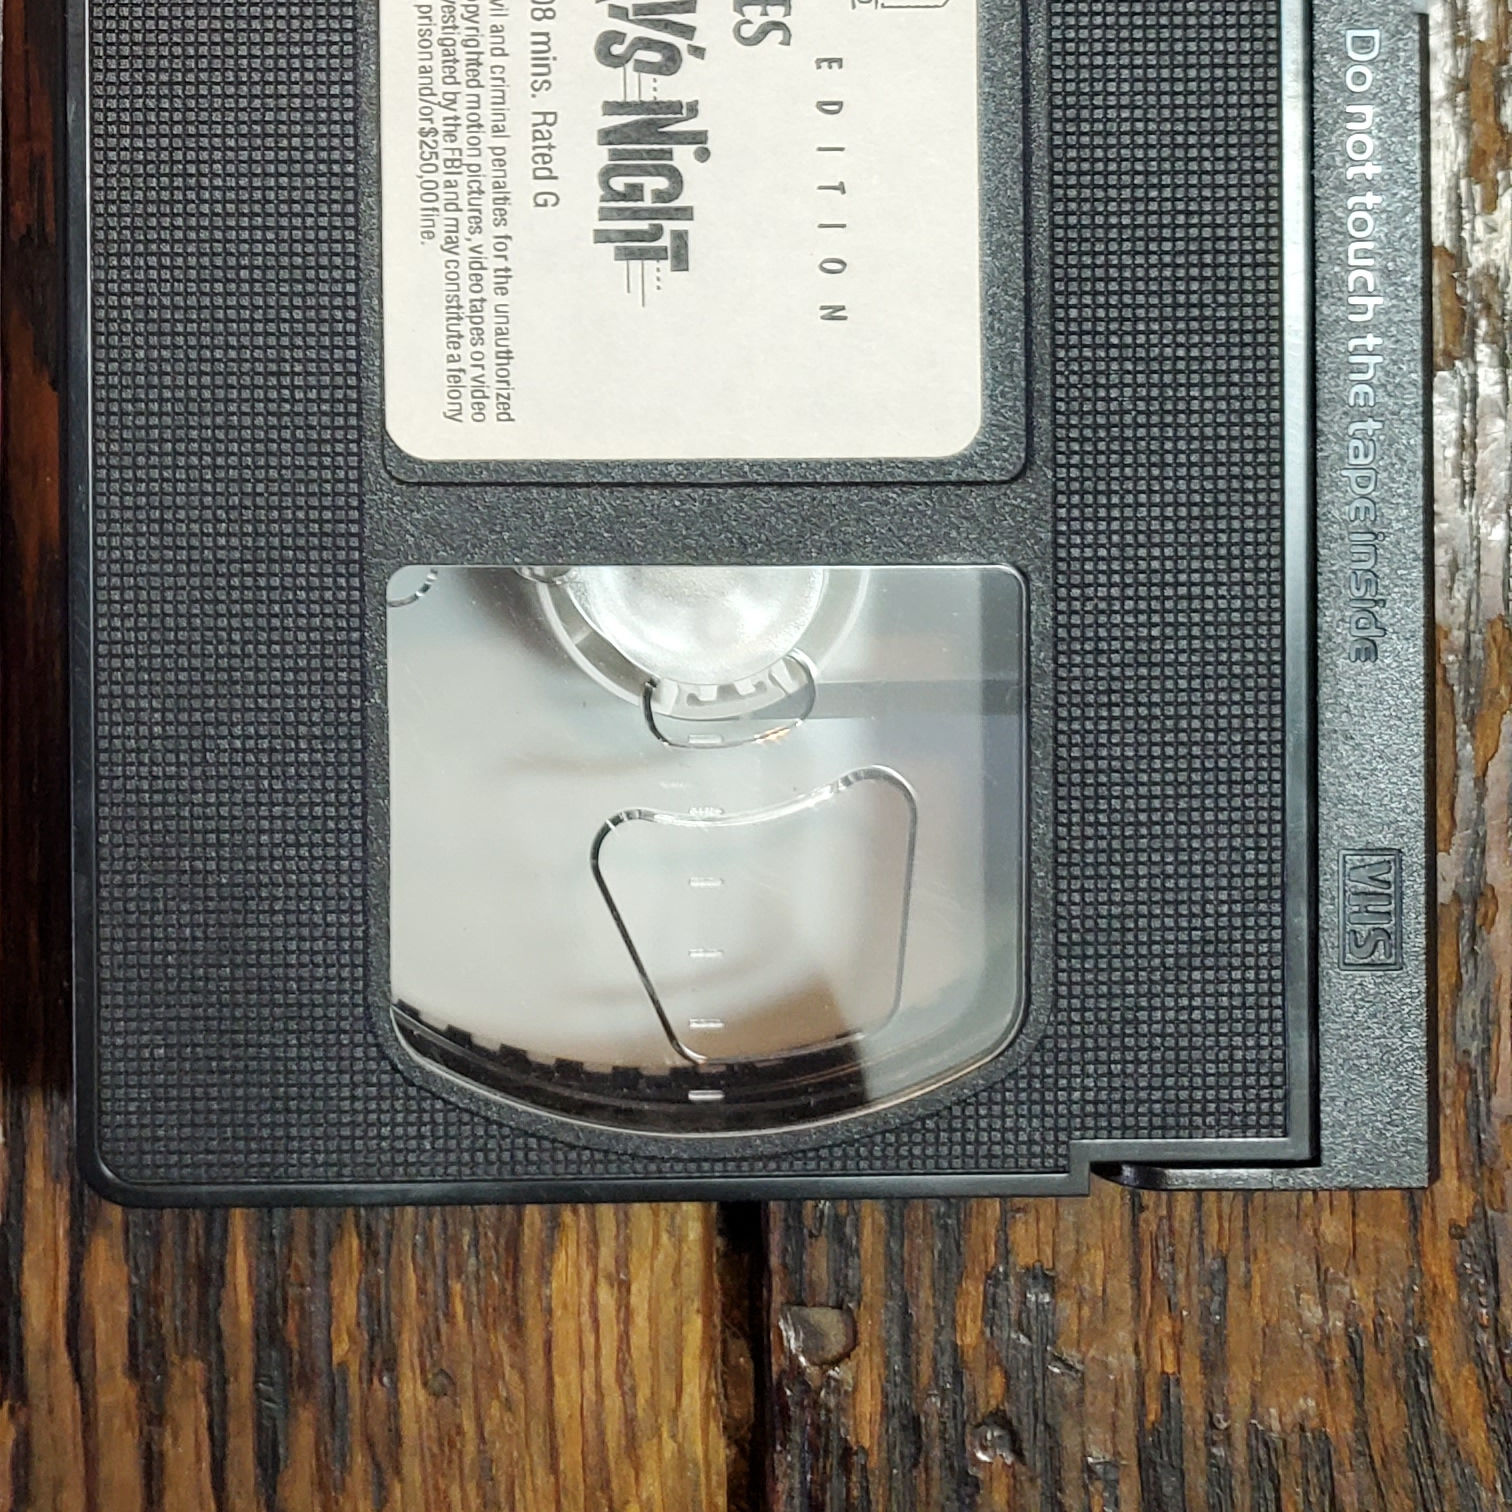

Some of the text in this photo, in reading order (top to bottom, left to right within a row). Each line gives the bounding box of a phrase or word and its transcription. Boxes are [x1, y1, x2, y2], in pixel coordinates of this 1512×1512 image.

[413, 4, 436, 60] prison
[489, 25, 509, 56] and
[530, 32, 558, 98] mins.
[417, 65, 439, 124] and/or
[438, 92, 461, 111] by
[490, 65, 510, 138] criminal
[443, 115, 463, 143] the
[465, 94, 485, 157] motion
[531, 111, 559, 180] Rated
[442, 147, 462, 174] FBI
[443, 179, 462, 212] and
[462, 163, 486, 242] pictures,
[488, 147, 512, 227] penalties
[532, 192, 560, 208] G
[815, 57, 848, 321] EDITION
[419, 207, 440, 246] fine.
[439, 217, 460, 255] may
[493, 235, 513, 261] for
[468, 245, 487, 293] video
[493, 266, 513, 296] the
[444, 259, 464, 350] constitute
[465, 297, 488, 347] tapes
[446, 354, 461, 364] a
[469, 351, 485, 370] or
[493, 304, 515, 422] unauthorized
[1341, 27, 1388, 664] Do not touch the tape inside
[442, 368, 466, 423] felony
[470, 374, 490, 422] video
[1348, 861, 1393, 960] VHS
